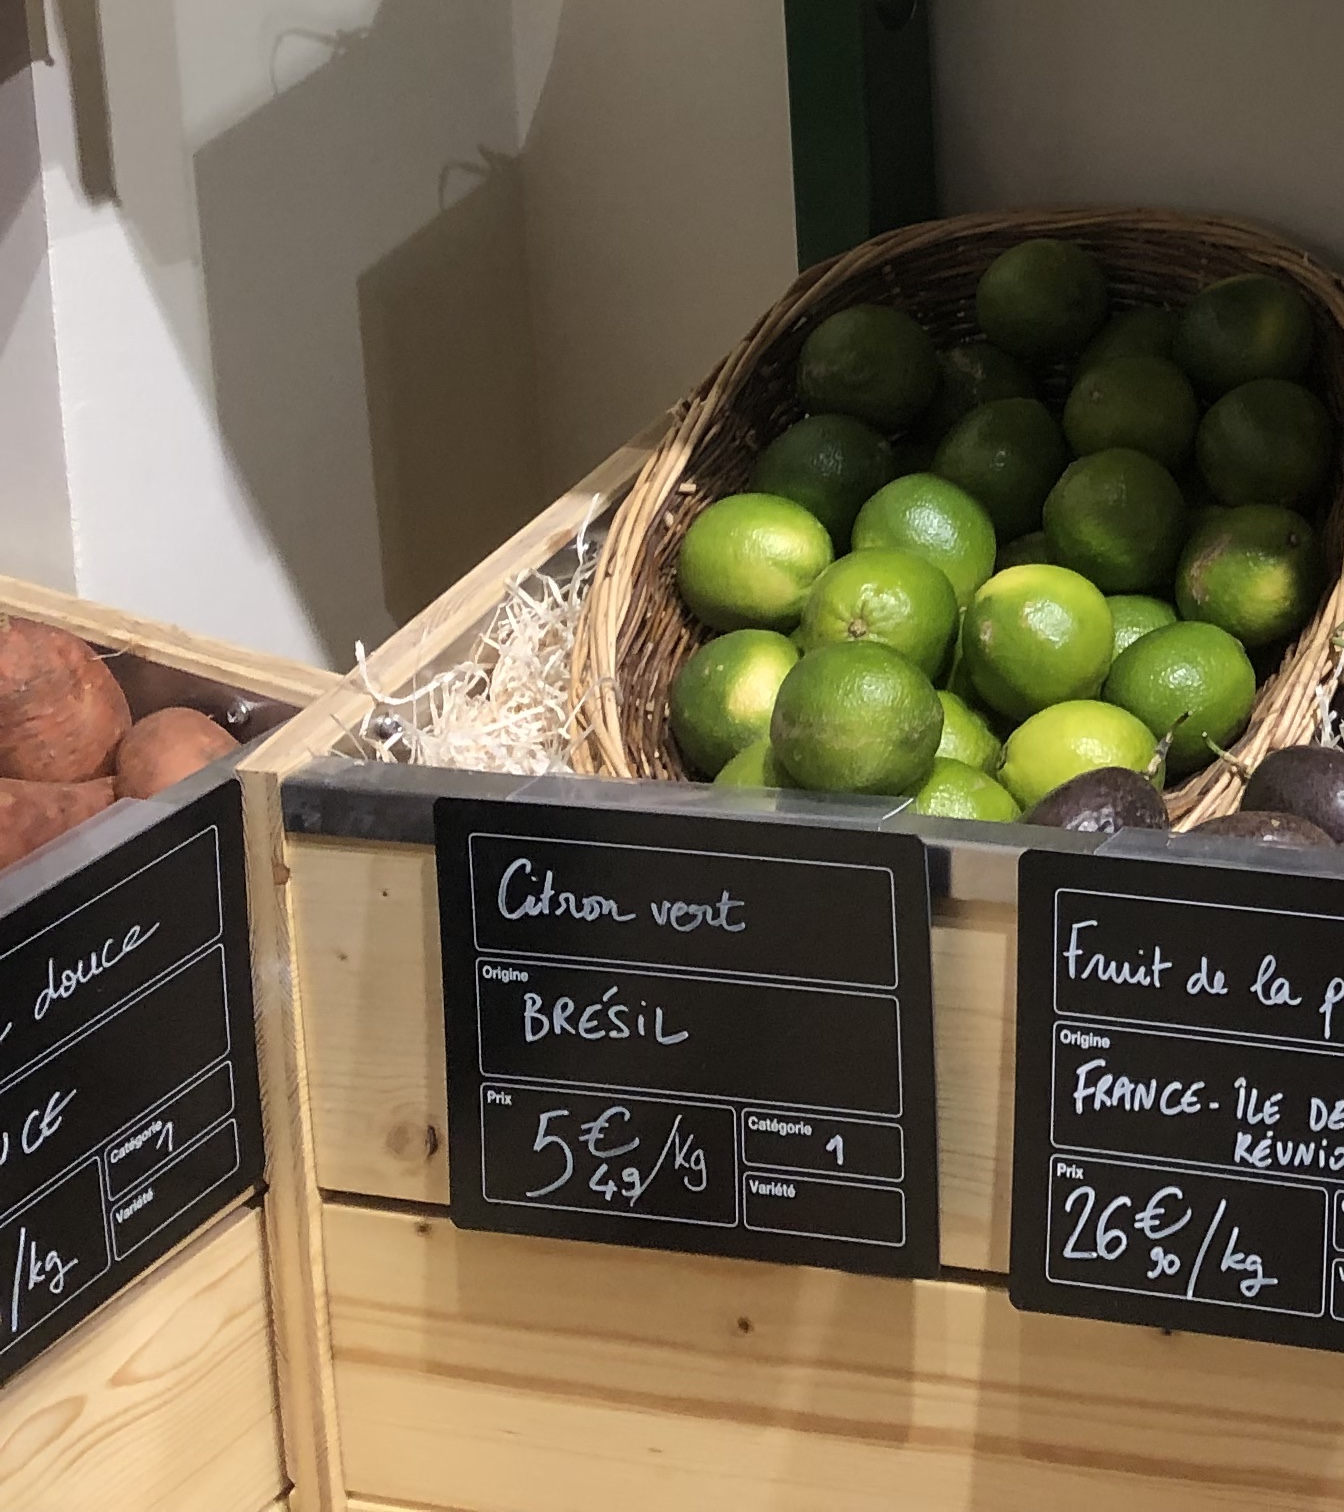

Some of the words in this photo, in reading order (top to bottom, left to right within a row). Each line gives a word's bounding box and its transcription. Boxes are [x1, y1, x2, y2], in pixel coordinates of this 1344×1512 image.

[498, 857, 637, 921] Citron
[650, 889, 747, 932] vert
[34, 921, 160, 1021] douce
[482, 966, 529, 983] Origine
[1063, 920, 1174, 989] Fruit
[1186, 956, 1229, 996] de
[1249, 954, 1303, 1006] la
[1059, 1031, 1111, 1050] Origine
[487, 1091, 512, 1106] Prix
[1235, 1077, 1284, 1126] ÎLE
[109, 1119, 163, 1164] Catégorie
[155, 1121, 173, 1152] 1
[747, 1116, 812, 1137] Catégorie
[825, 1134, 844, 1166] 1
[1056, 1163, 1084, 1180] Prix
[749, 1181, 796, 1200] Variété
[115, 1189, 155, 1224] Variété
